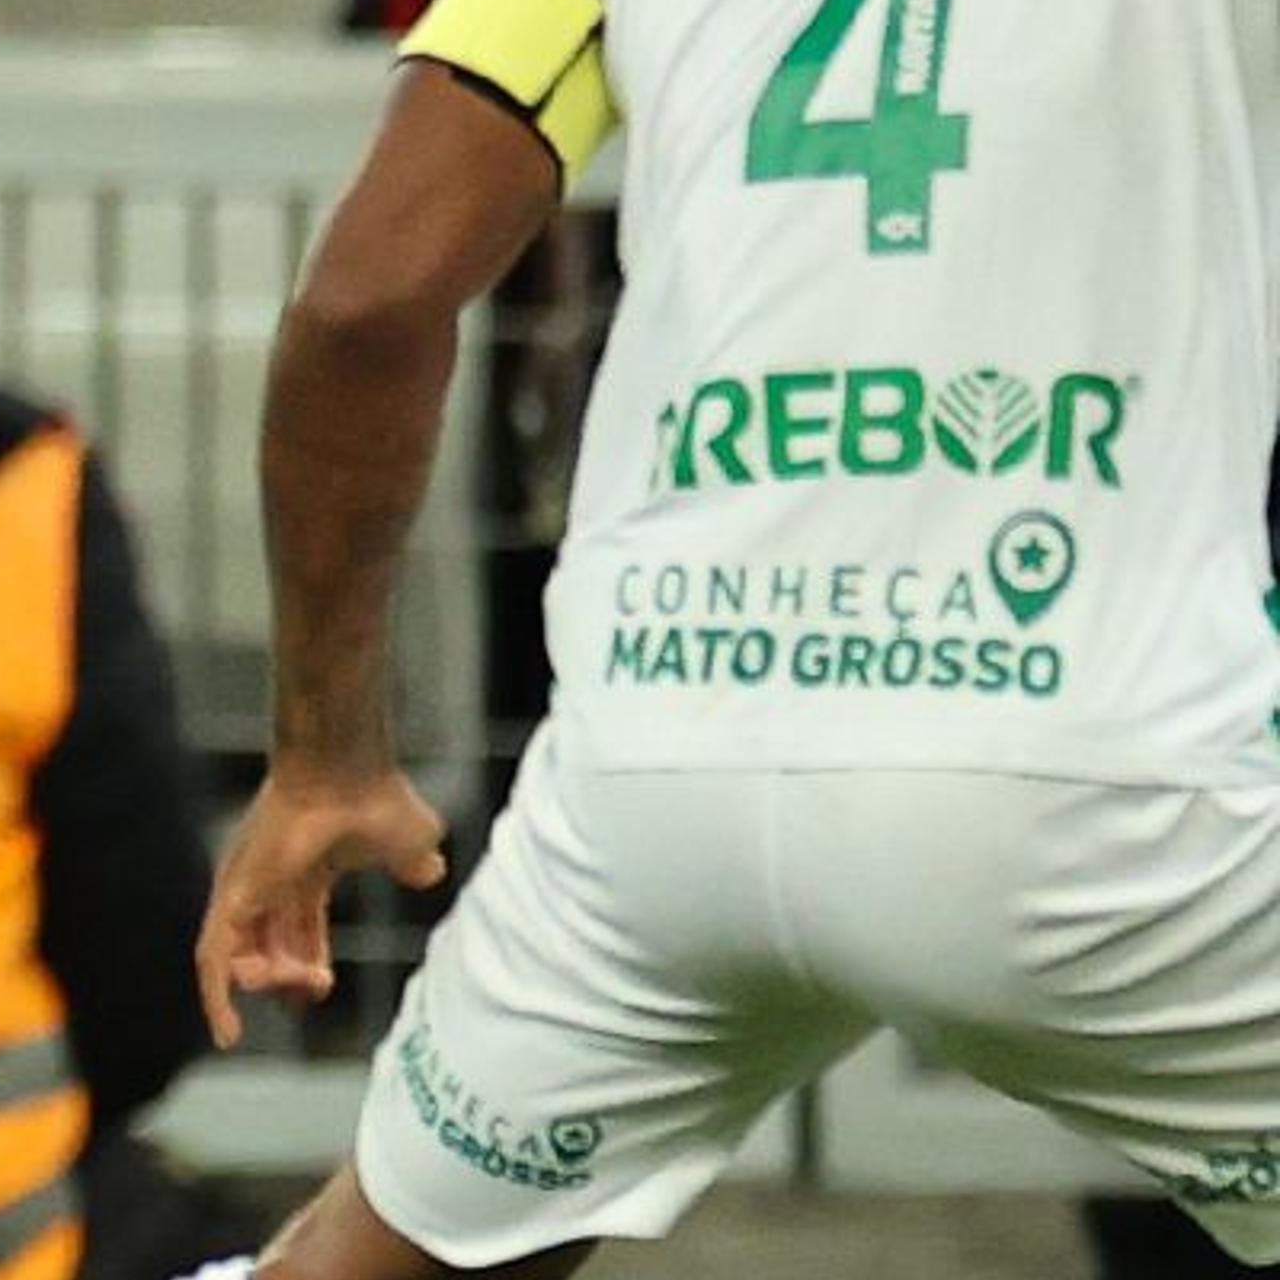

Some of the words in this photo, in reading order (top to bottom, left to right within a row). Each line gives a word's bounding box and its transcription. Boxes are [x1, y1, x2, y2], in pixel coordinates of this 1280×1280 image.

[615, 562, 978, 639] CONHEÇA
[606, 626, 777, 685] MATO
[789, 630, 1062, 697] GROSSO
